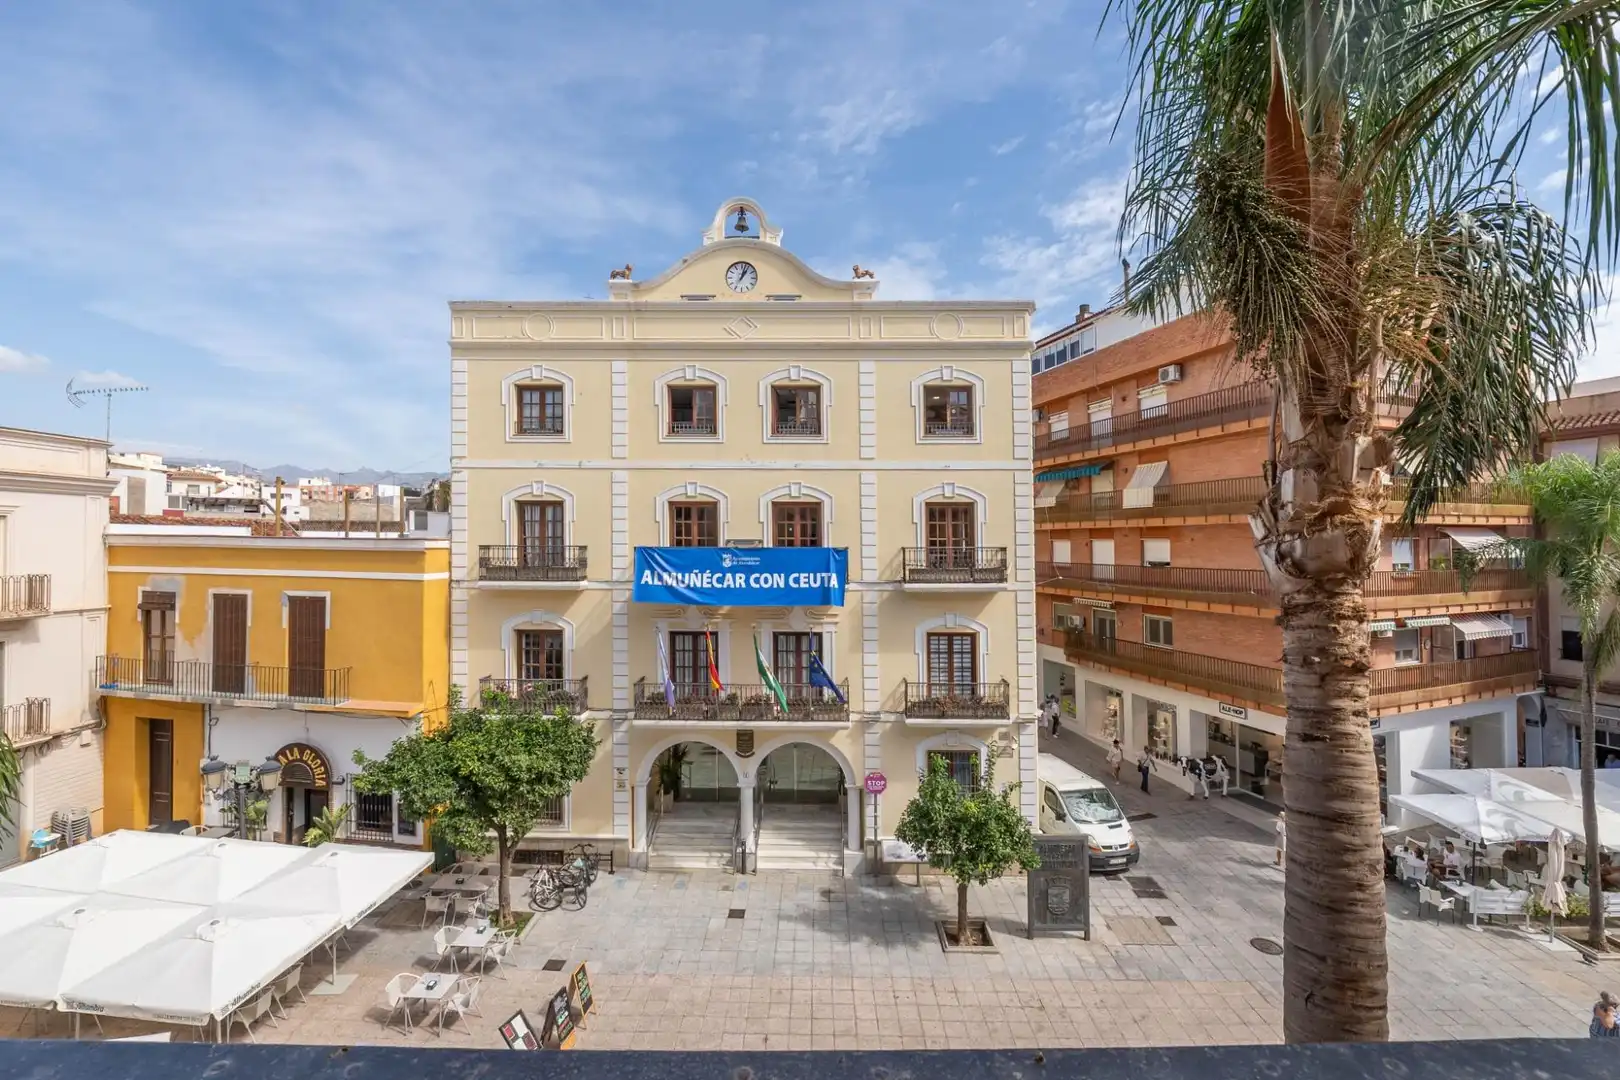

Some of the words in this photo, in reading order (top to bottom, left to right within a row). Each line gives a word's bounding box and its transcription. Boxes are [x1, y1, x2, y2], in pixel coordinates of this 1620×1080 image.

[640, 568, 746, 588] ALMUÑÉCAR
[749, 572, 785, 588] CON
[788, 572, 839, 588] CEUTA
[286, 747, 300, 760] LA
[302, 749, 327, 787] GLORIA
